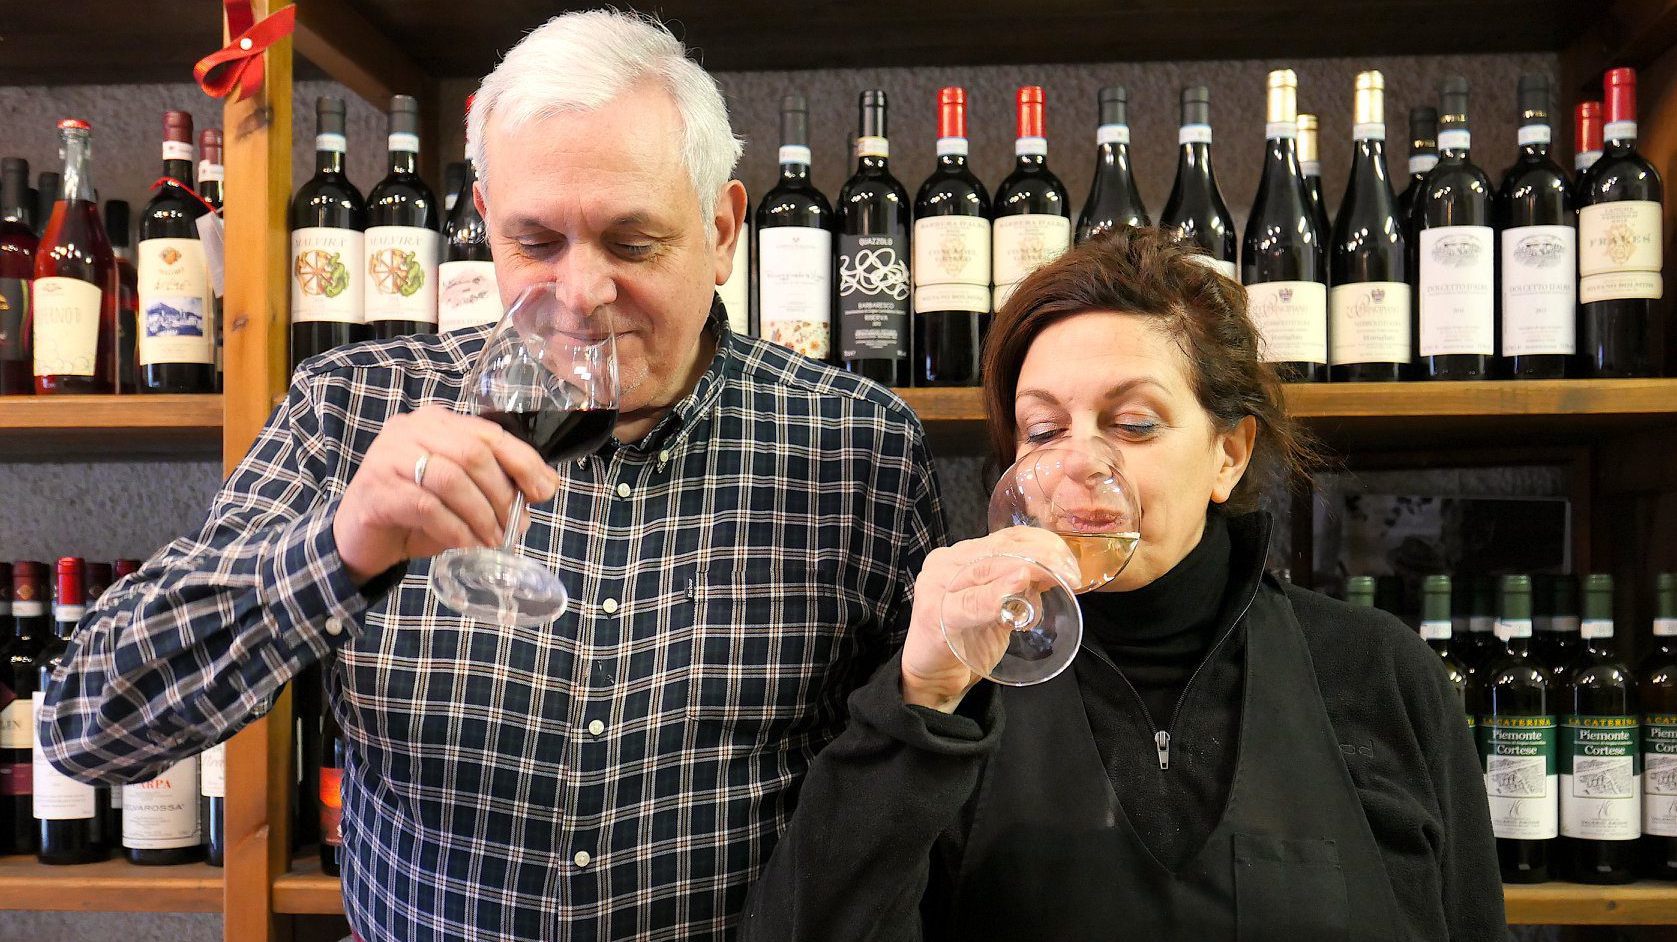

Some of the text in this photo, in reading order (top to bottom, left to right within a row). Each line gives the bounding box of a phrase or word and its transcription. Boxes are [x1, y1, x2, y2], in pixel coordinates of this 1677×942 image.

[858, 237, 894, 246] QUAZZOLO
[1493, 729, 1543, 741] Piemonte
[1580, 729, 1630, 741] Piemonte
[1497, 744, 1538, 756] Cortese
[1584, 744, 1626, 756] Cortese
[137, 780, 172, 789] ARPA
